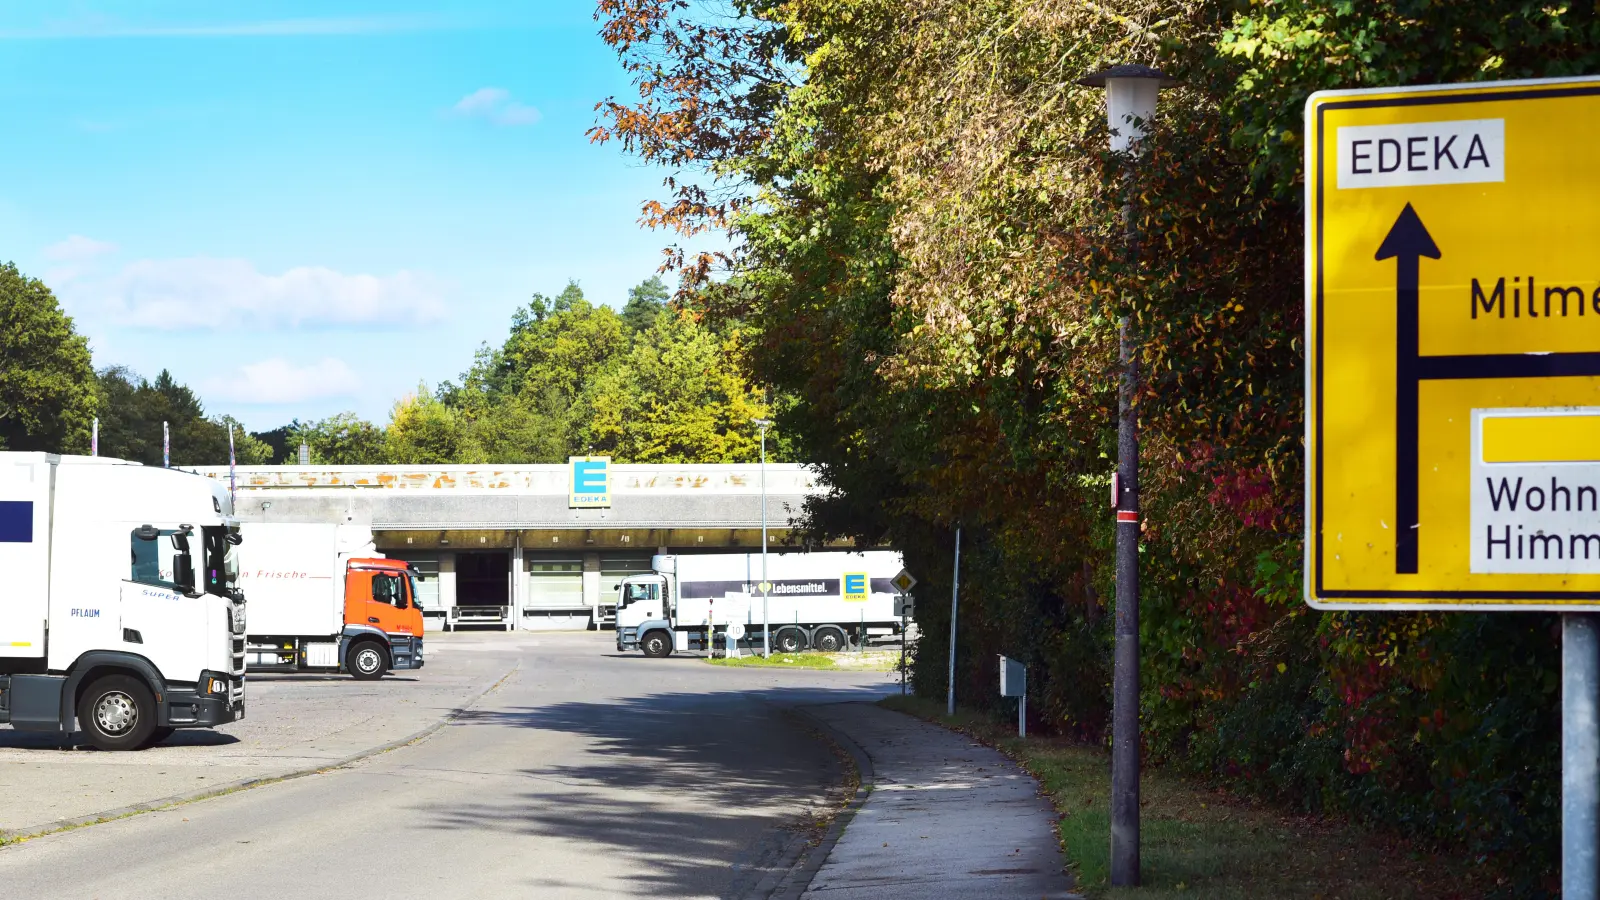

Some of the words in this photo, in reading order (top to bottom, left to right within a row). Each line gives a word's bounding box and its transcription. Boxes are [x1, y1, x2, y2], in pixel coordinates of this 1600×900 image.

[1352, 133, 1490, 175] EDEKA
[1486, 476, 1597, 512] Wohn
[1487, 524, 1600, 559] Himm
[256, 569, 307, 579] Frische
[742, 583, 757, 594] Wir
[772, 582, 828, 594] Lebensmittel.
[142, 589, 180, 601] SUPER
[71, 608, 100, 618] PFLAUM
[732, 626, 741, 635] 10
